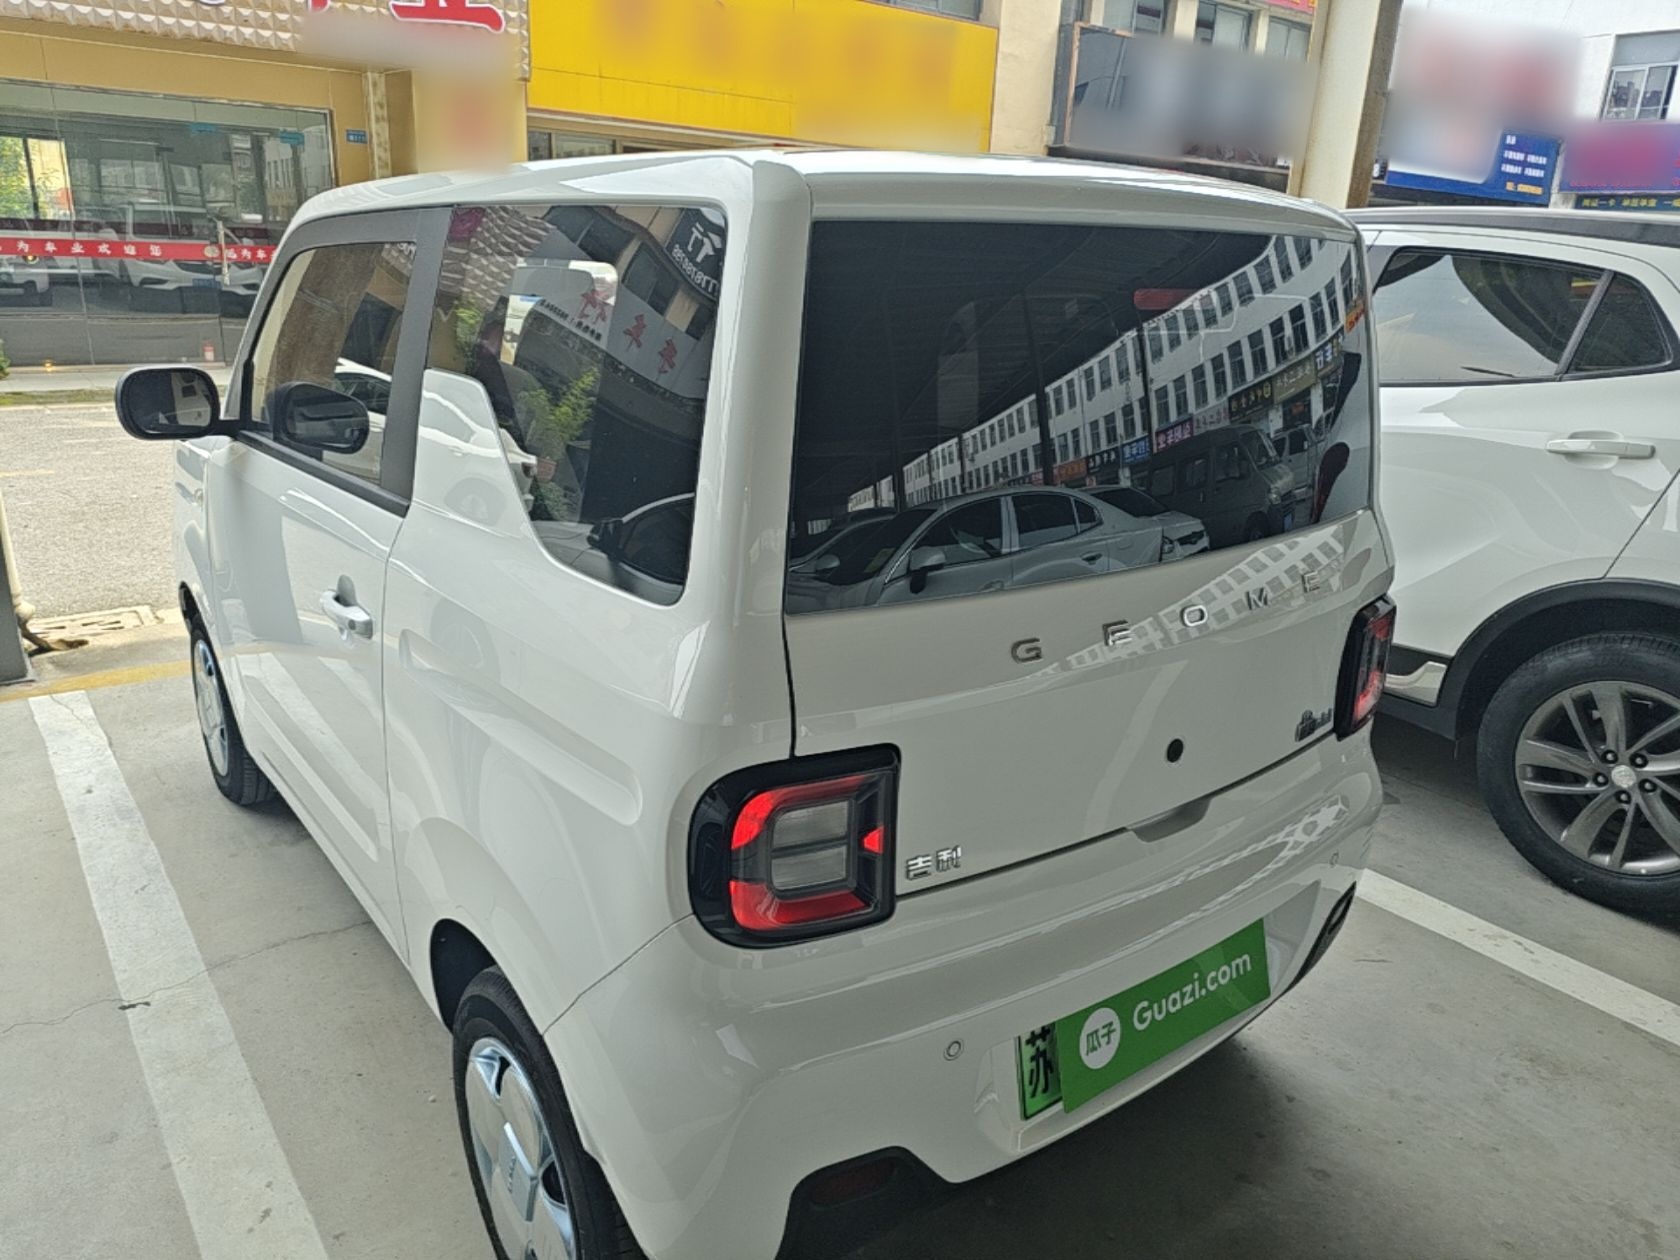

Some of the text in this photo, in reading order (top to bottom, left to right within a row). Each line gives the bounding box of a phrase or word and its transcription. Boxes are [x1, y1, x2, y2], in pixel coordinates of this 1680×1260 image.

[0, 239, 162, 257] 为车业欢迎您
[1011, 571, 1321, 664] GEOME
[905, 845, 962, 880] 吉利
[1024, 1025, 1054, 1099] 苏
